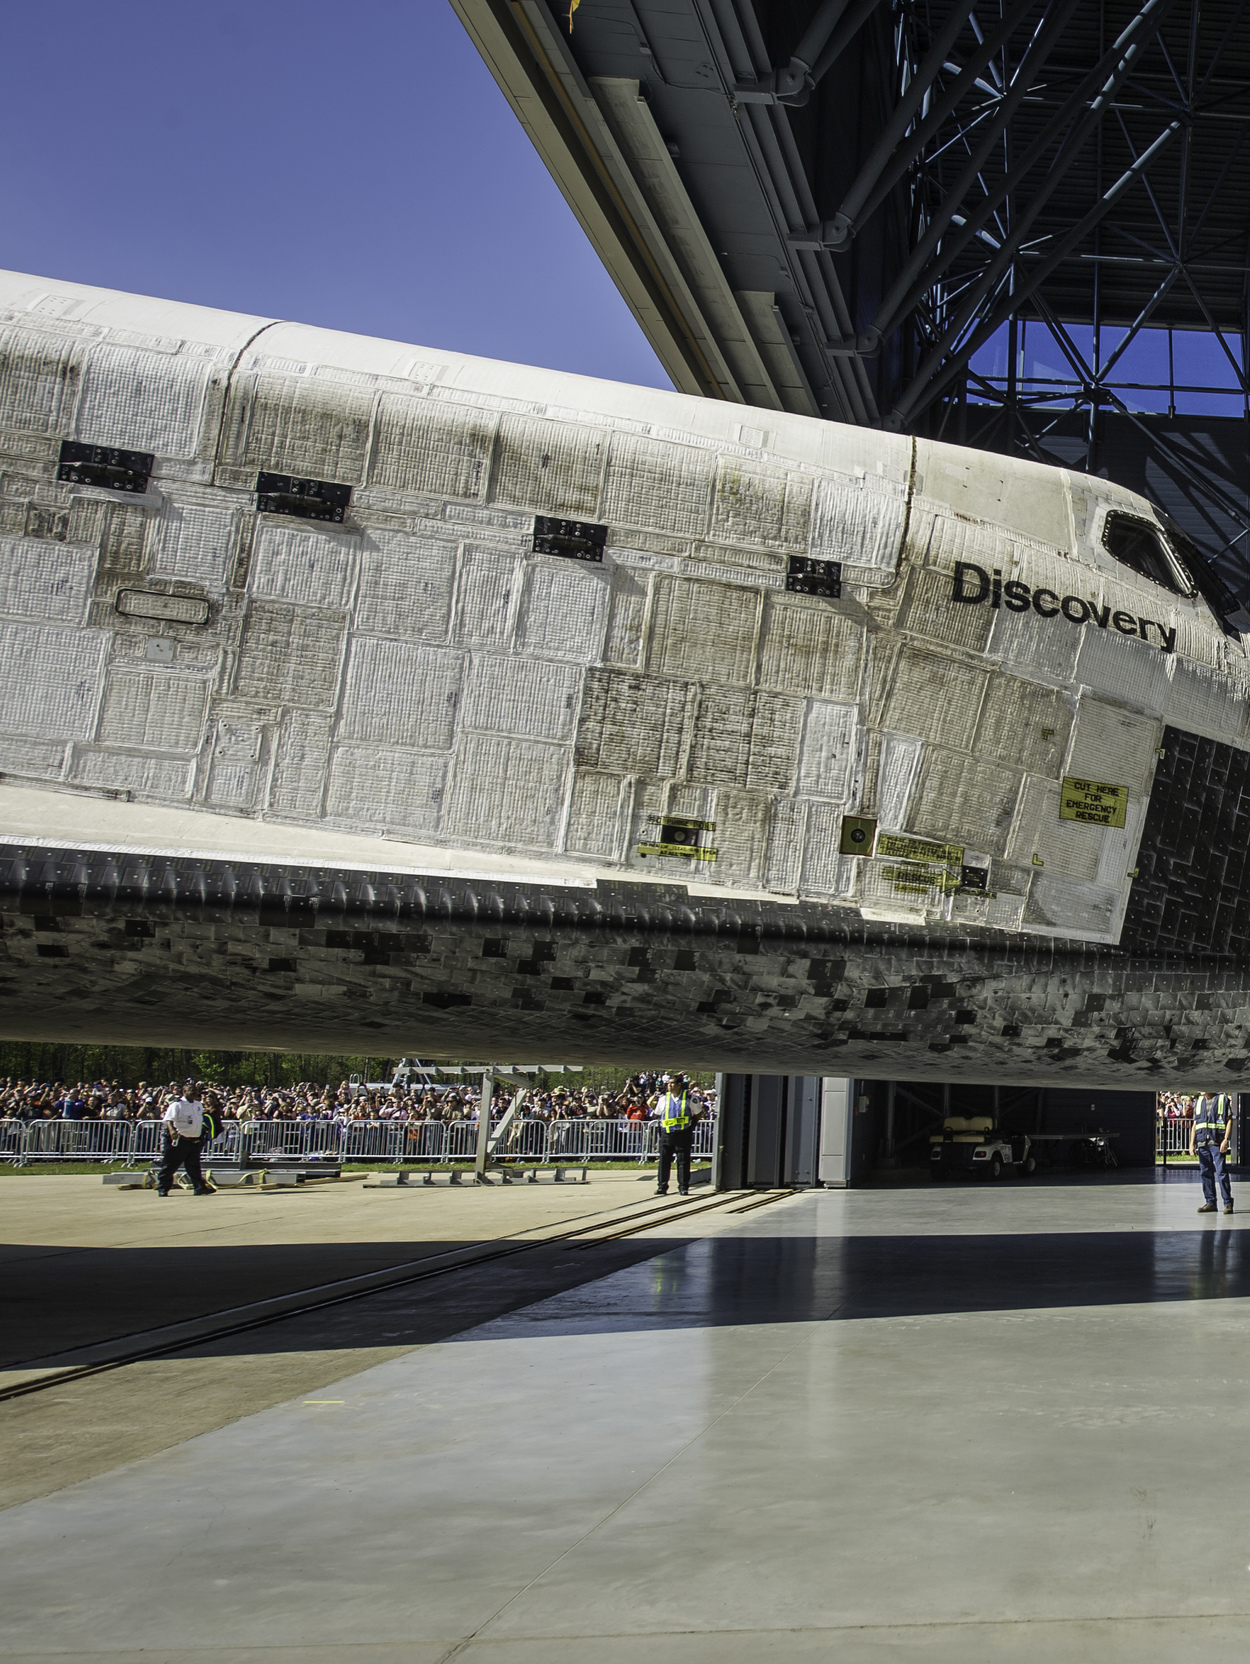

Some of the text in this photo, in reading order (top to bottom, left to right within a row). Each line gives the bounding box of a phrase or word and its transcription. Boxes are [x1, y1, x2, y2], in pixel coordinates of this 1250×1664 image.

[952, 561, 1176, 654] Discovery
[1074, 782, 1120, 797] CUT HERE
[1084, 793, 1102, 803] FOR
[1066, 799, 1117, 815] EMERGENCY
[1075, 810, 1110, 824] RESCUE
